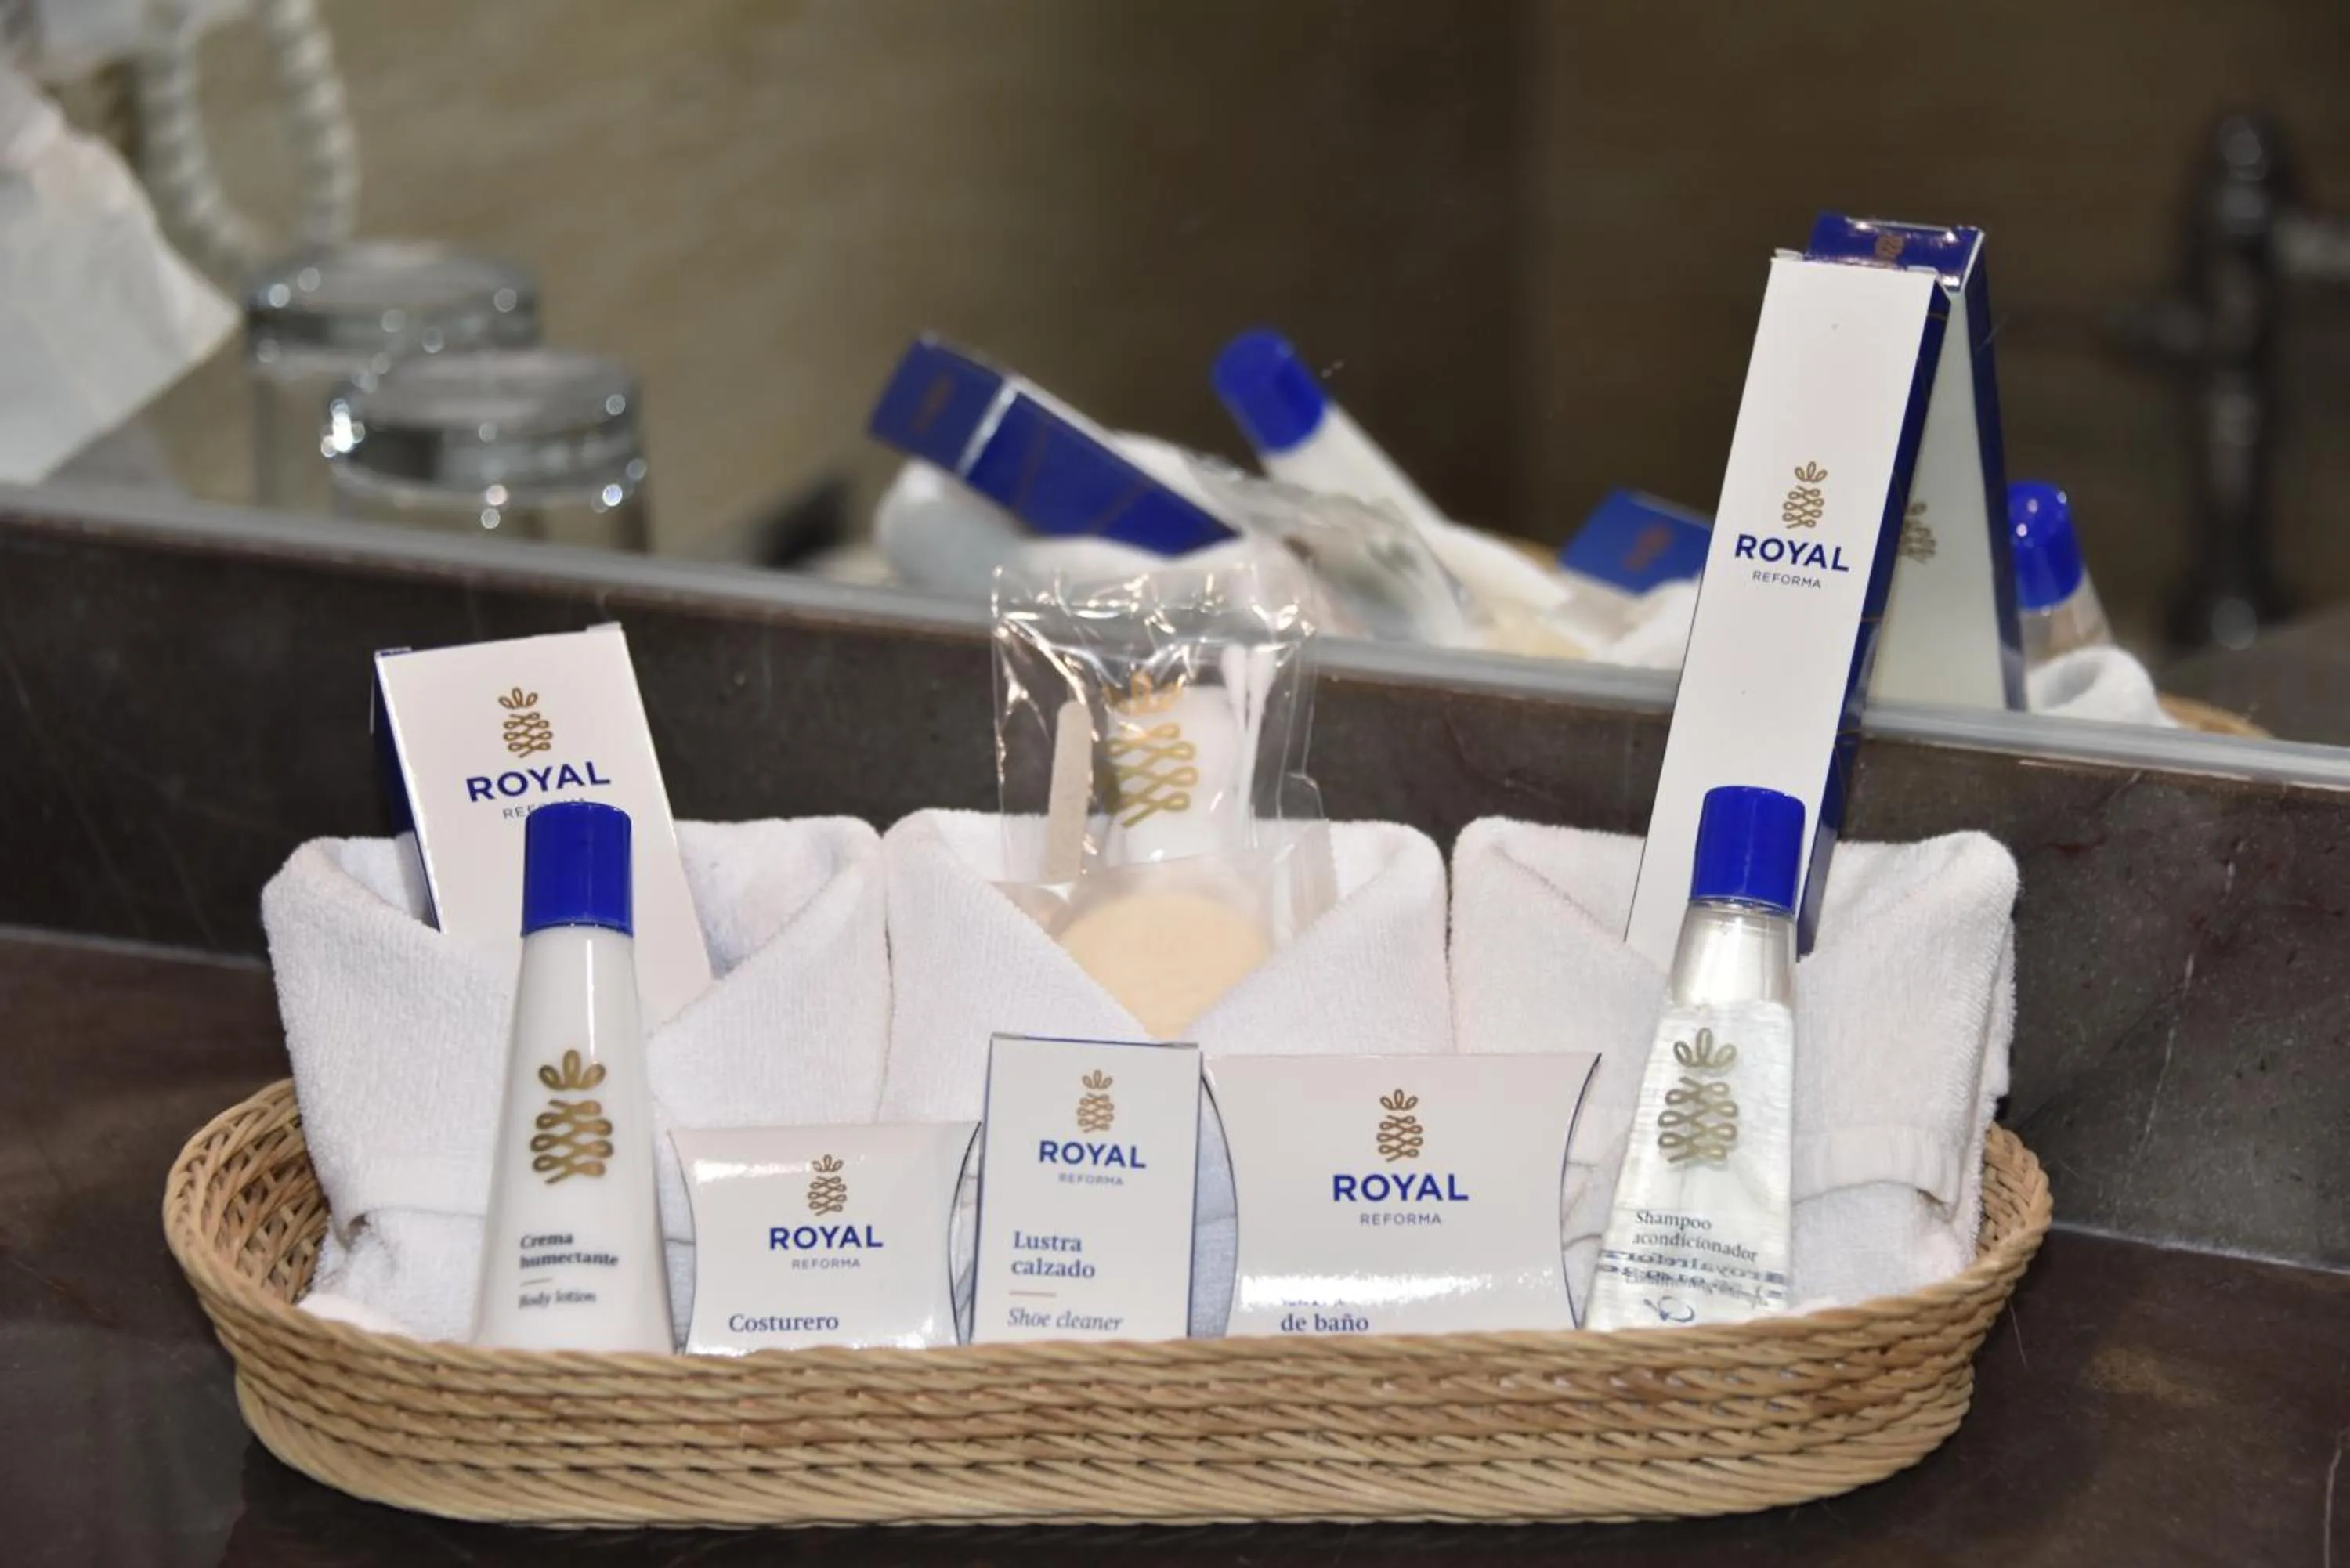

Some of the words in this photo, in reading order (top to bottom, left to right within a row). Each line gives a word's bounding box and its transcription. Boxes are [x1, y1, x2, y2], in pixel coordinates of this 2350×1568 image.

[1734, 533, 1849, 573] ROYAL
[1752, 569, 1822, 589] REFORMA
[465, 761, 611, 803] ROYAL
[1038, 1140, 1147, 1169] ROYAL
[1058, 1173, 1125, 1186] REFORMA
[1332, 1173, 1470, 1202] ROYAL
[1359, 1212, 1443, 1227] REFORMA
[1634, 1209, 1712, 1230] Shampoo
[519, 1232, 574, 1249] Crema
[769, 1224, 884, 1250] ROYAL
[1013, 1230, 1083, 1253] Lustra
[519, 1252, 619, 1270] humectante
[791, 1258, 861, 1270] REFORMA
[1010, 1257, 1096, 1279] calzado
[518, 1291, 551, 1310] Body
[555, 1289, 597, 1303] lotion
[728, 1313, 840, 1333] Costurero
[1007, 1306, 1051, 1328] Shoe
[1055, 1309, 1124, 1331] cleaner
[1280, 1312, 1307, 1332] de
[1314, 1312, 1369, 1333] baño
